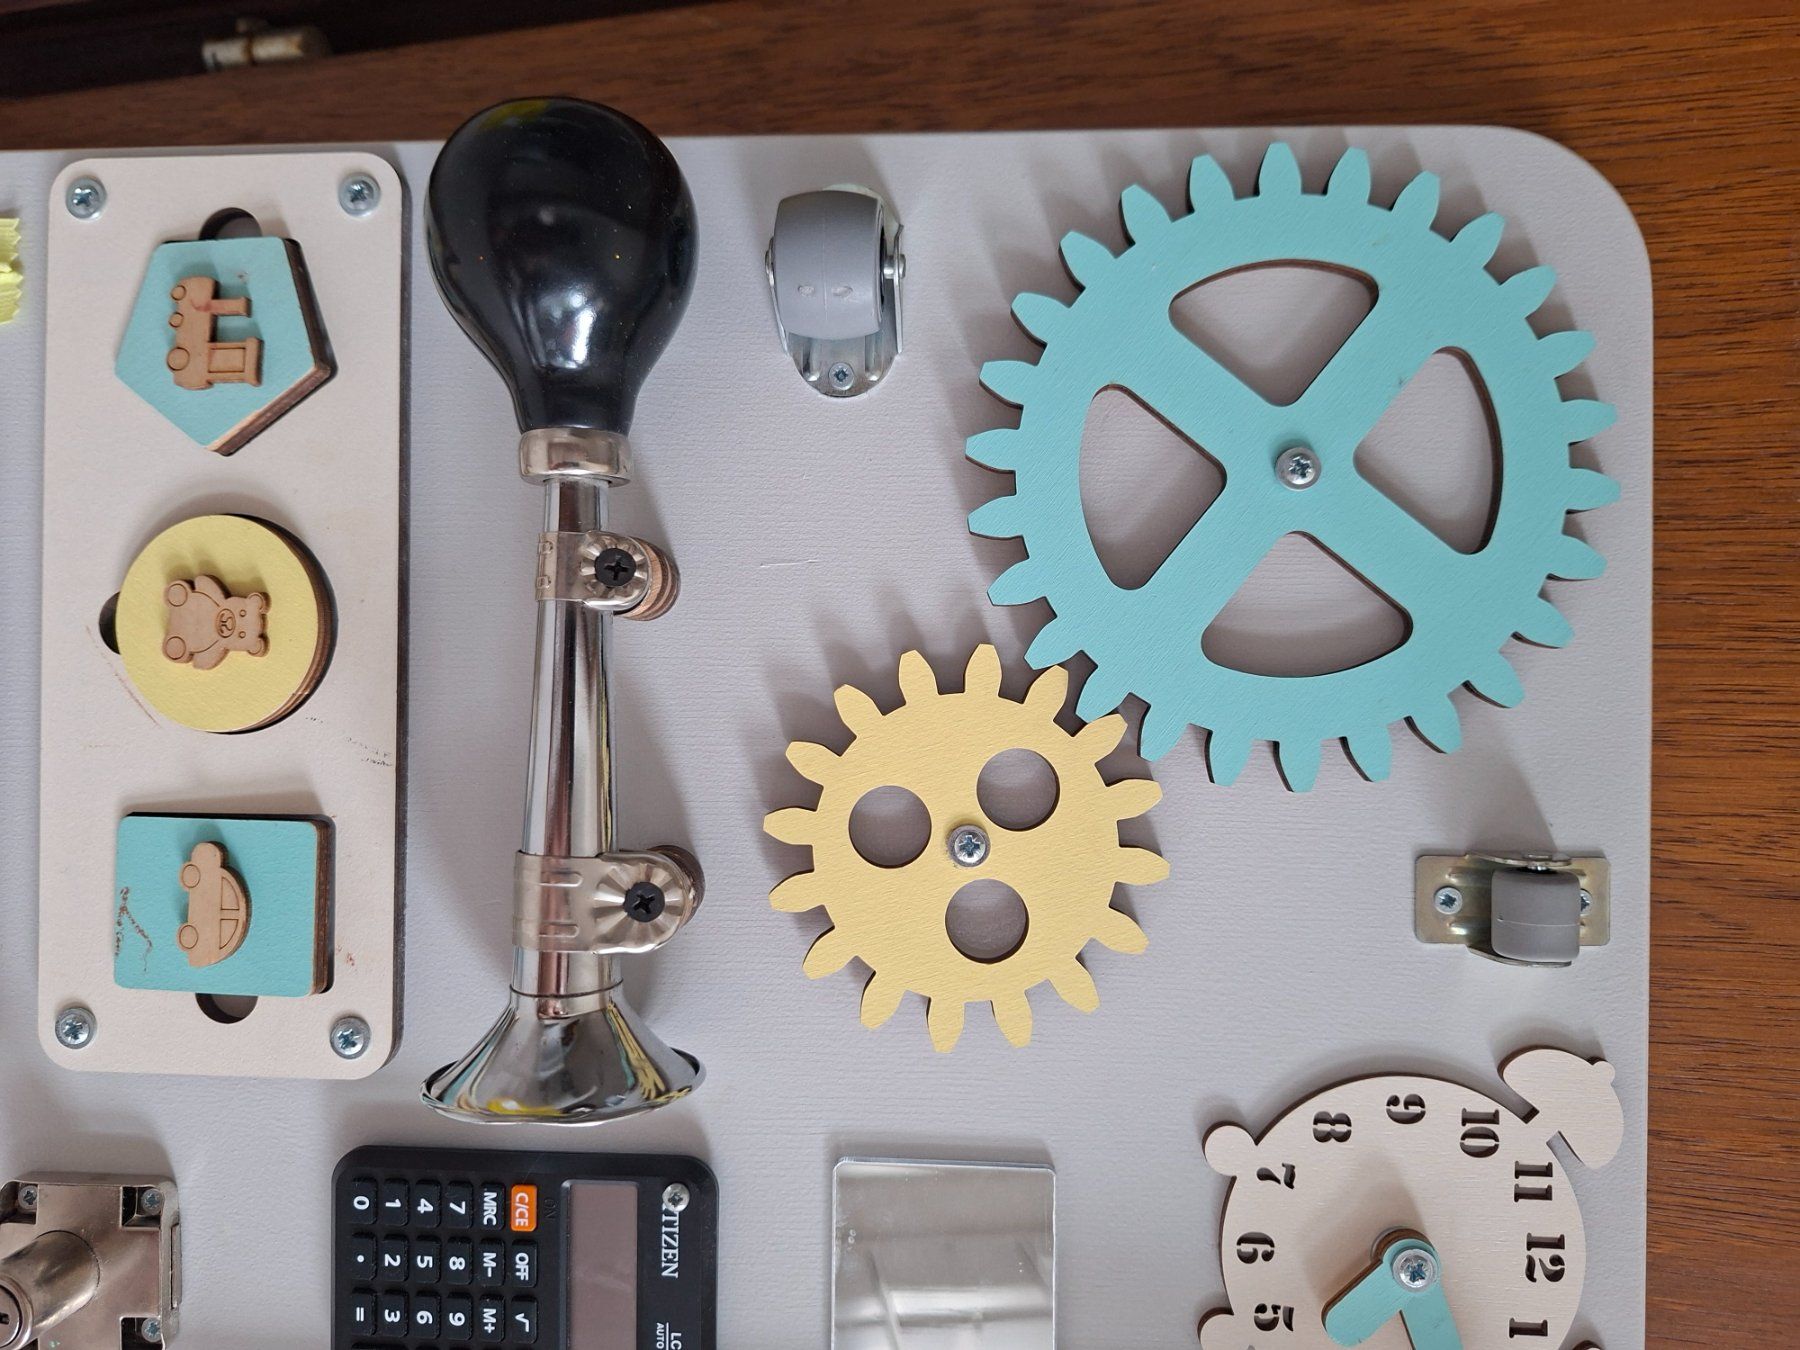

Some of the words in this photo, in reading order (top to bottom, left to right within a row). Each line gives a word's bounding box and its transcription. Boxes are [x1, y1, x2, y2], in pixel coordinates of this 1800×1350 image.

[1386, 1094, 1426, 1124] 9
[1312, 1111, 1352, 1143] 8
[1460, 1108, 1500, 1158] 10
[1256, 1162, 1296, 1190] 7
[1514, 1160, 1553, 1202] 11
[354, 1196, 370, 1210] 0
[386, 1199, 402, 1208] 1
[417, 1198, 434, 1214] 4
[450, 1201, 466, 1214] 7
[484, 1192, 498, 1226] MRC
[515, 1192, 528, 1227] C/CE
[662, 1203, 679, 1278] TIZEN
[1236, 1232, 1275, 1264] 6
[384, 1254, 400, 1266] 2
[417, 1255, 432, 1268] 5
[450, 1256, 466, 1270] 8
[515, 1252, 528, 1280] OFF
[1525, 1232, 1565, 1283] 12
[384, 1309, 400, 1323] 3
[416, 1310, 432, 1324] 6
[449, 1312, 465, 1326] 9
[483, 1308, 496, 1334] M+
[1254, 1303, 1294, 1332] 5
[1508, 1317, 1548, 1338] 1
[656, 1322, 664, 1349] AUTO
